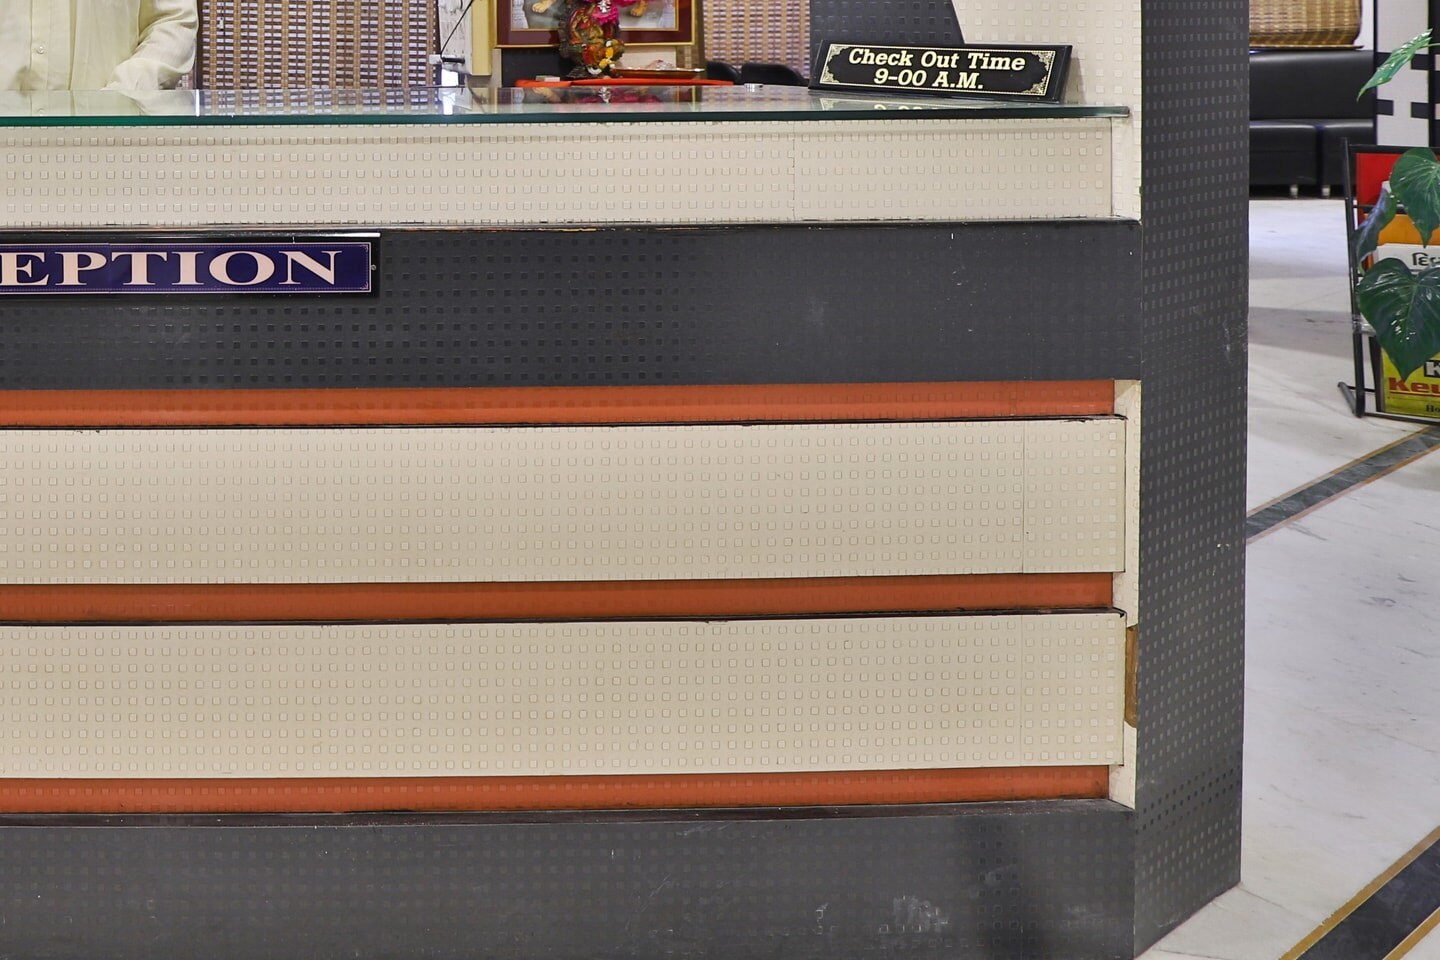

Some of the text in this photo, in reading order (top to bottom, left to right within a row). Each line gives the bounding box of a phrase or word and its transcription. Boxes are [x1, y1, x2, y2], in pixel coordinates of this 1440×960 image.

[848, 48, 1026, 72] Check Out Time
[873, 68, 984, 90] 9-00 A.M.
